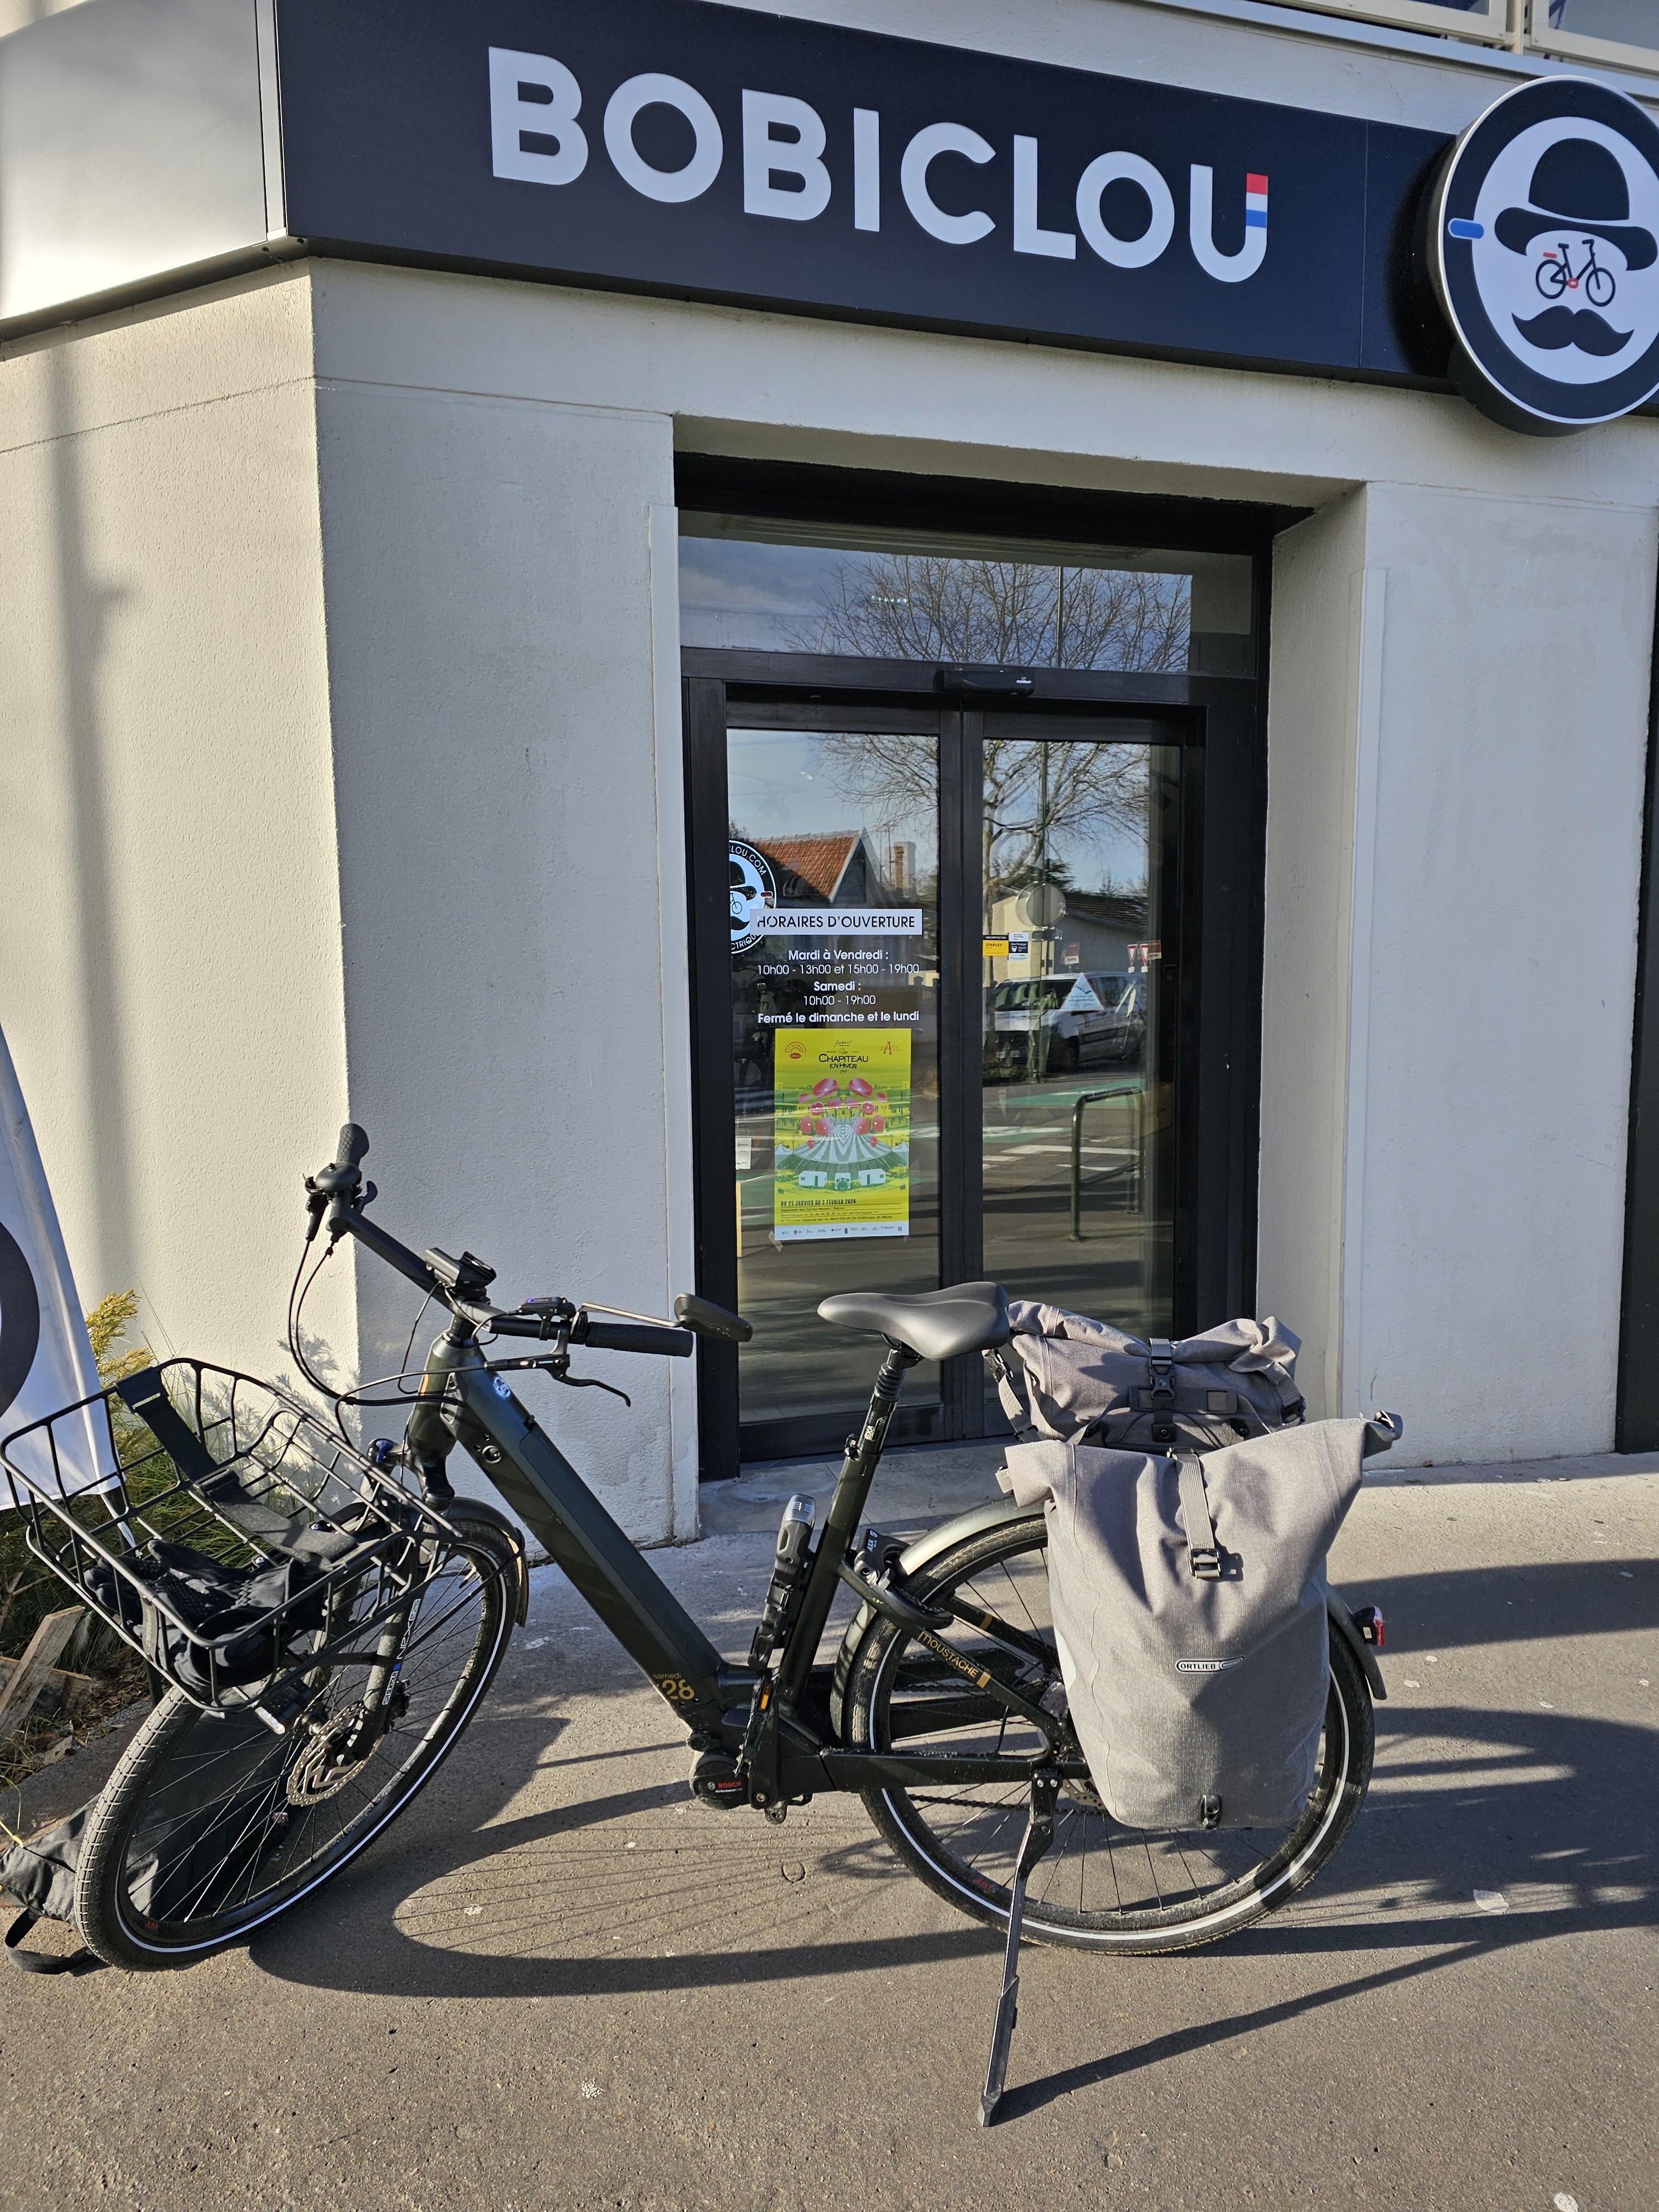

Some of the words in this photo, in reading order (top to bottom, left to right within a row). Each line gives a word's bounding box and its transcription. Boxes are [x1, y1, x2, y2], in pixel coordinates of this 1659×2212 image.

[488, 46, 1268, 283] BOBICLOU
[729, 846, 766, 876] LOU.COM
[757, 915, 823, 927] HORAIRES
[828, 915, 915, 928] D'OUVERTURE
[789, 950, 820, 960] Mardi
[823, 949, 831, 959] à
[834, 950, 883, 960] Vendredi
[758, 964, 790, 975] 10h00
[800, 964, 831, 974] 13h00
[834, 965, 845, 974] et
[848, 964, 879, 974] 15h00
[889, 964, 920, 973] 19h00
[813, 981, 855, 992] Samedi
[804, 995, 835, 1006] 10h00
[846, 995, 877, 1005] 19h00
[758, 1013, 792, 1024] Fermé
[796, 1014, 806, 1023] le
[809, 1013, 864, 1023] dimanche
[868, 1013, 879, 1022] et
[881, 1012, 891, 1022] le
[894, 1011, 919, 1021] lundi
[818, 1053, 869, 1062] CHAPITEAU
[661, 1679, 695, 1700] 28
